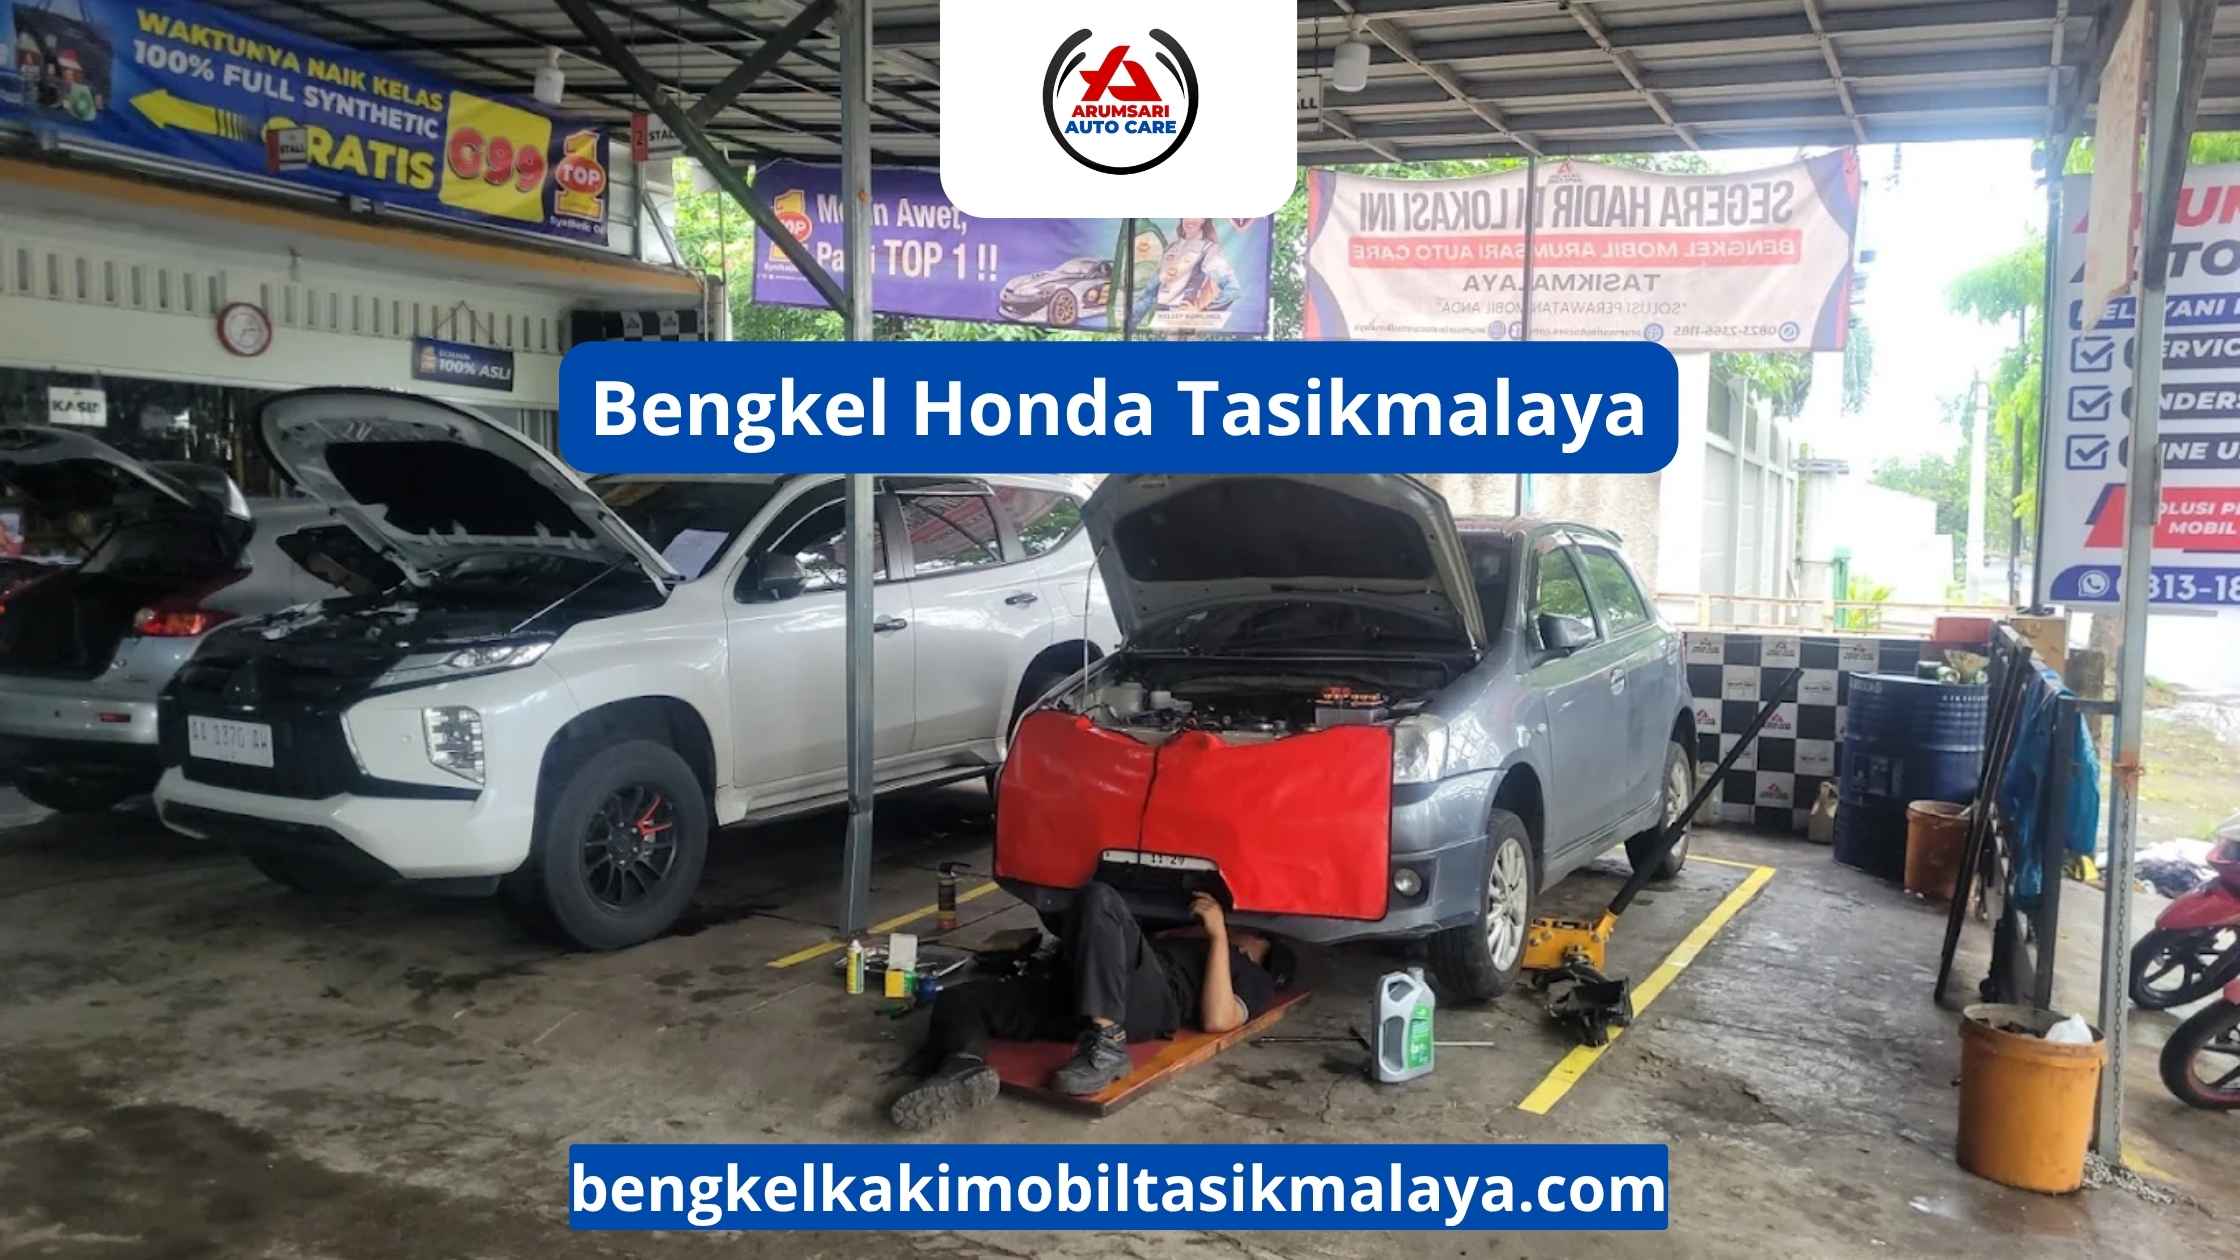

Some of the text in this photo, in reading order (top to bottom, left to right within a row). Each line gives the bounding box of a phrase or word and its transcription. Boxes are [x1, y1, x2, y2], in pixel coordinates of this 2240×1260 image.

[136, 8, 443, 112] WAKTUNYA NAIK KELAS
[133, 40, 439, 139] 100% FULL SYNTHETIC
[562, 164, 600, 185] TOP
[897, 198, 967, 235] Awet,
[816, 241, 876, 273] Pai
[883, 240, 943, 278] TOP
[952, 243, 966, 280] 1
[439, 358, 511, 380] 100% ASLI
[2159, 501, 2216, 516] OLUSI
[2168, 521, 2237, 535] MOBIL
